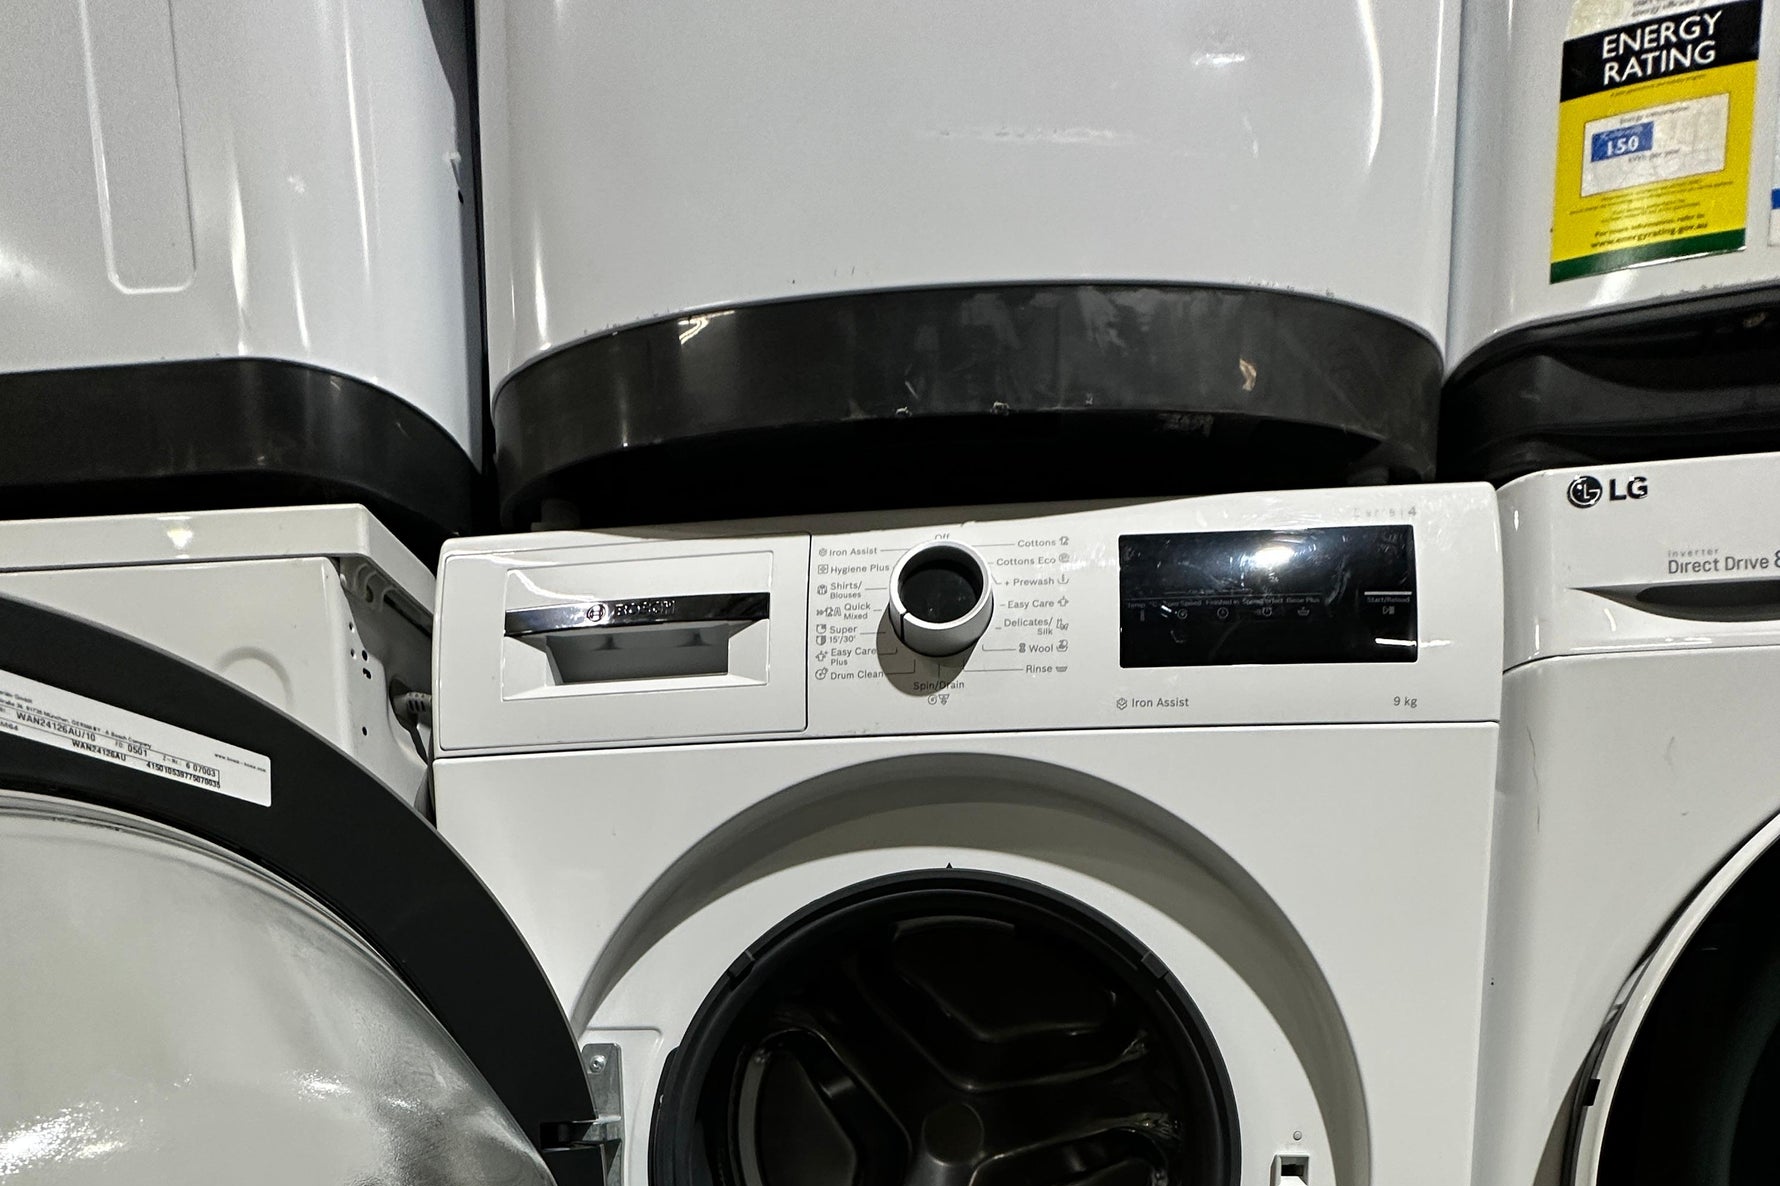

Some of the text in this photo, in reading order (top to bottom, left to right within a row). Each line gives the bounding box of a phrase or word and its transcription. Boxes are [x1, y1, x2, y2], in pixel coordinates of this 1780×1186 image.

[1602, 11, 1722, 59] ENERGY
[1603, 40, 1716, 86] RATING
[1607, 135, 1639, 156] 150
[1609, 476, 1648, 501] LG
[1017, 539, 1057, 547] Cottons
[829, 547, 877, 557] Iron Assist
[996, 558, 1035, 566] Cottons
[1668, 557, 1719, 574] Direct
[1724, 555, 1769, 571] Drive
[830, 564, 890, 575] Hygiene Plus
[830, 581, 863, 591] Shirts/
[1013, 577, 1055, 586] Prewash
[830, 591, 862, 599] Blouses
[844, 602, 871, 611] Quick
[1007, 599, 1055, 610] Easy Care
[1004, 617, 1054, 628] Delicates/
[830, 625, 858, 635] Super
[1037, 628, 1053, 636] Silk
[830, 647, 877, 657] Easy Care
[1029, 645, 1054, 653] Wool
[830, 658, 848, 666] Plus
[1025, 665, 1053, 674] Rinse
[830, 670, 884, 680] Drum Clean
[913, 680, 965, 691] Spin/Drain
[1131, 697, 1189, 707] Iron Assist
[1393, 696, 1418, 709] 9 kg
[16, 711, 96, 742] WAN24126AU/10
[71, 739, 126, 761] WAN24126AU
